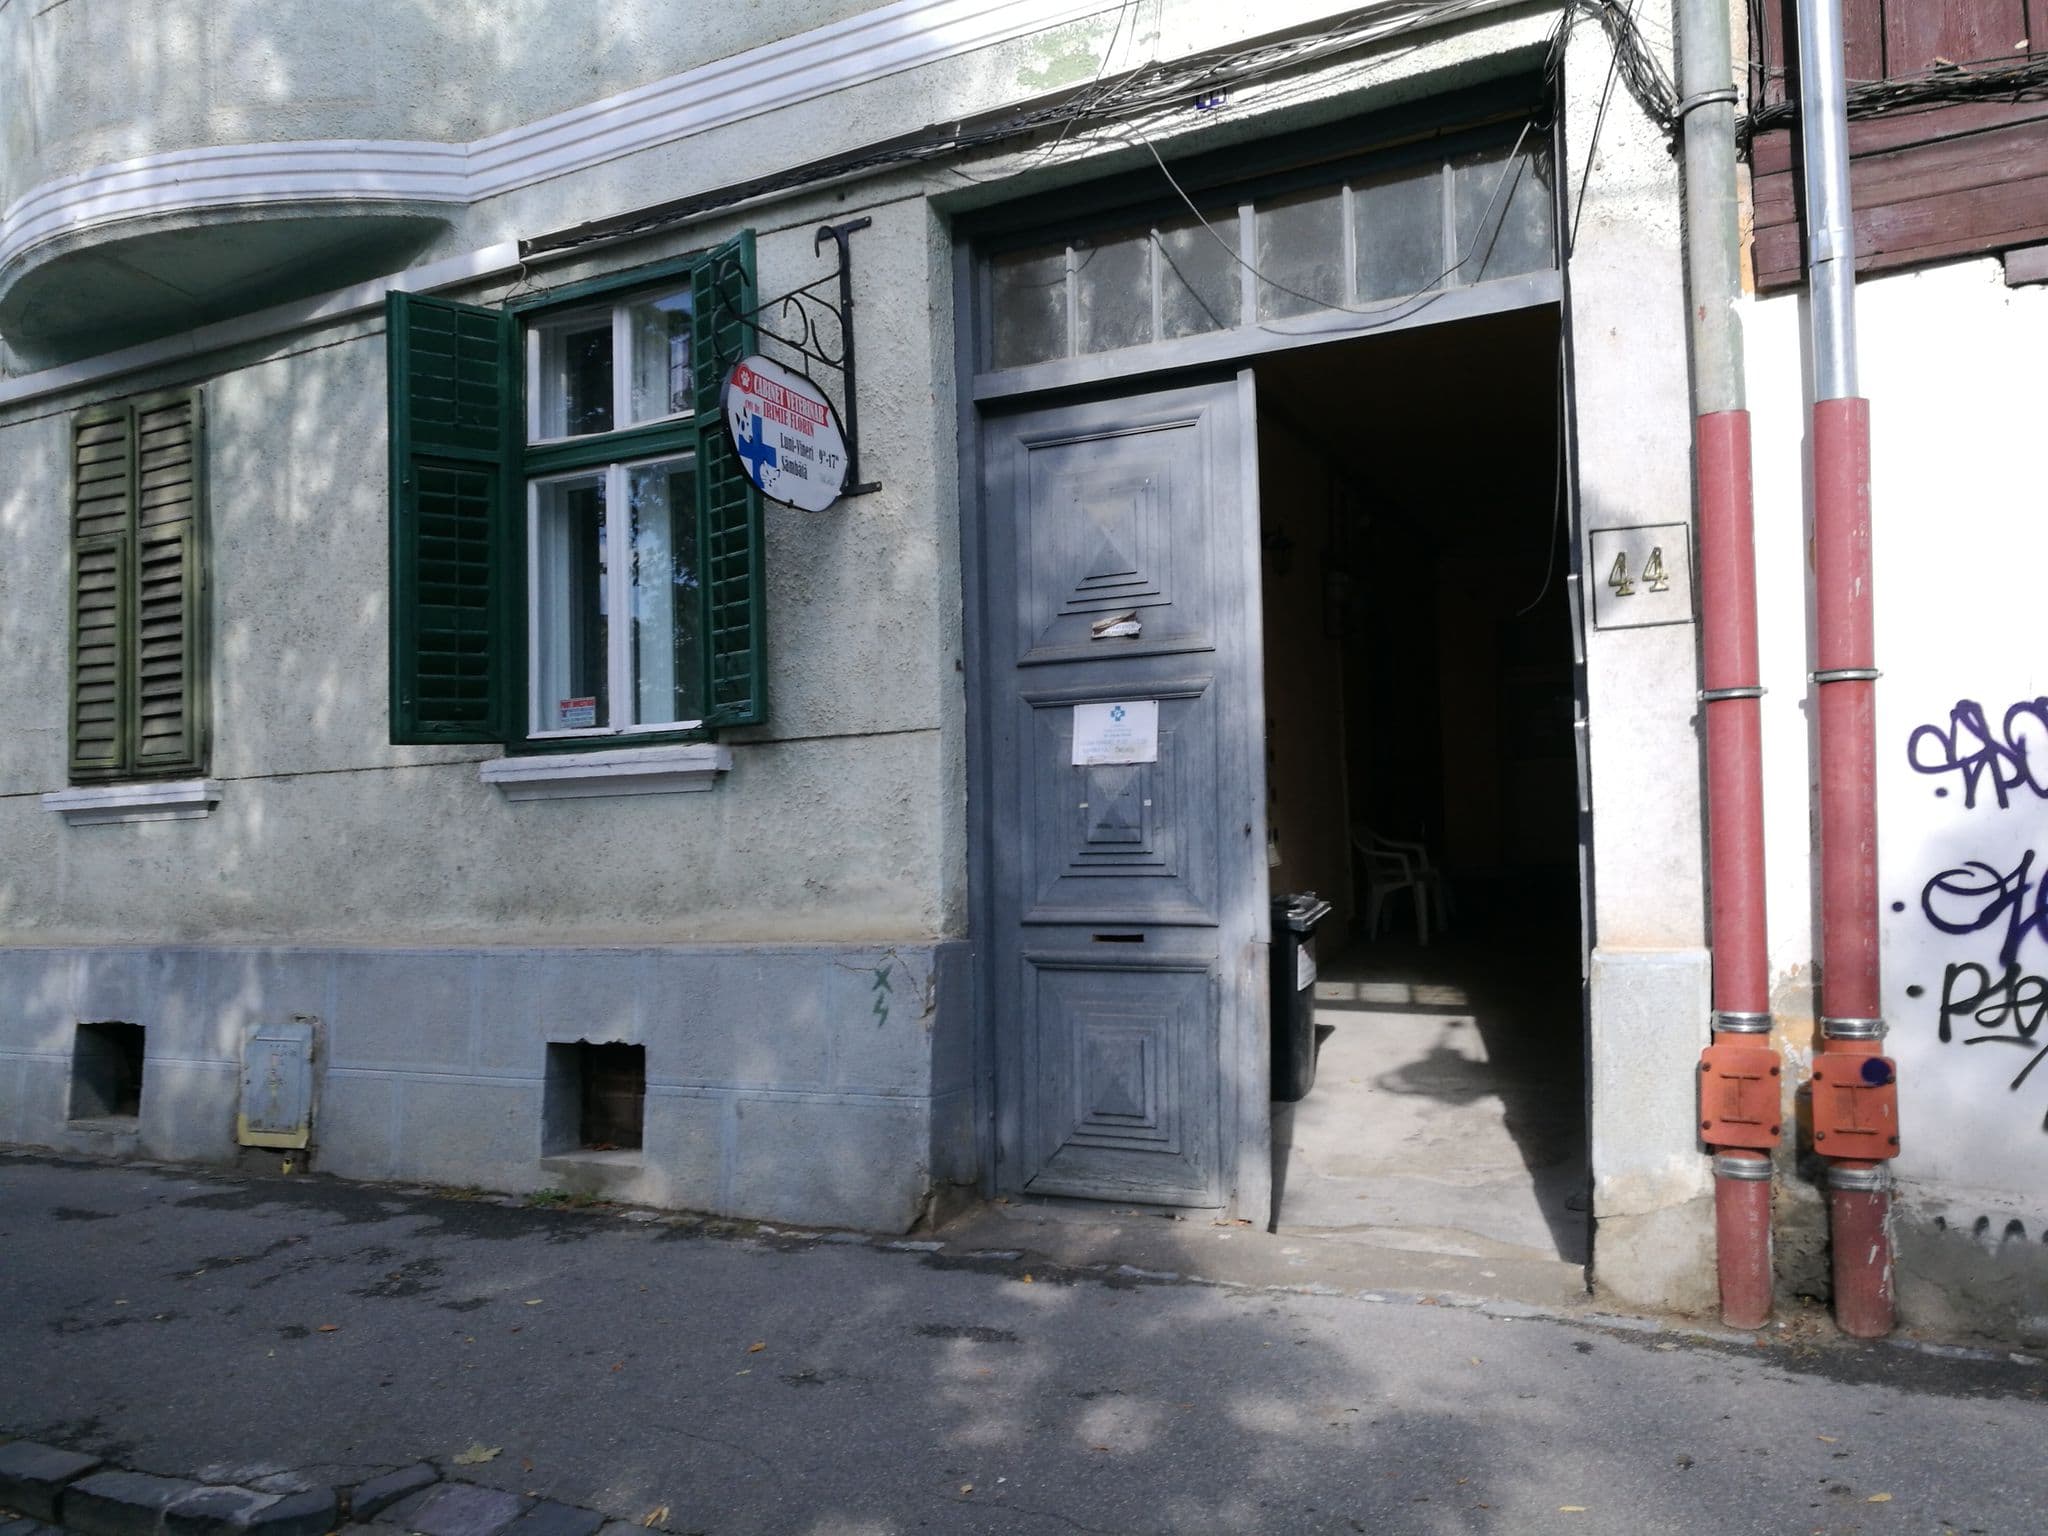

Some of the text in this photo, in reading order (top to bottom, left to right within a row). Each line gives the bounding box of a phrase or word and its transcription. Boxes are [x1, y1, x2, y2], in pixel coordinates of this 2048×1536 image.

[754, 375, 825, 424] CABINET VETERINAR
[763, 401, 787, 425] IRIMIE
[790, 412, 814, 437] FLORIN
[1608, 546, 1670, 597] 44
